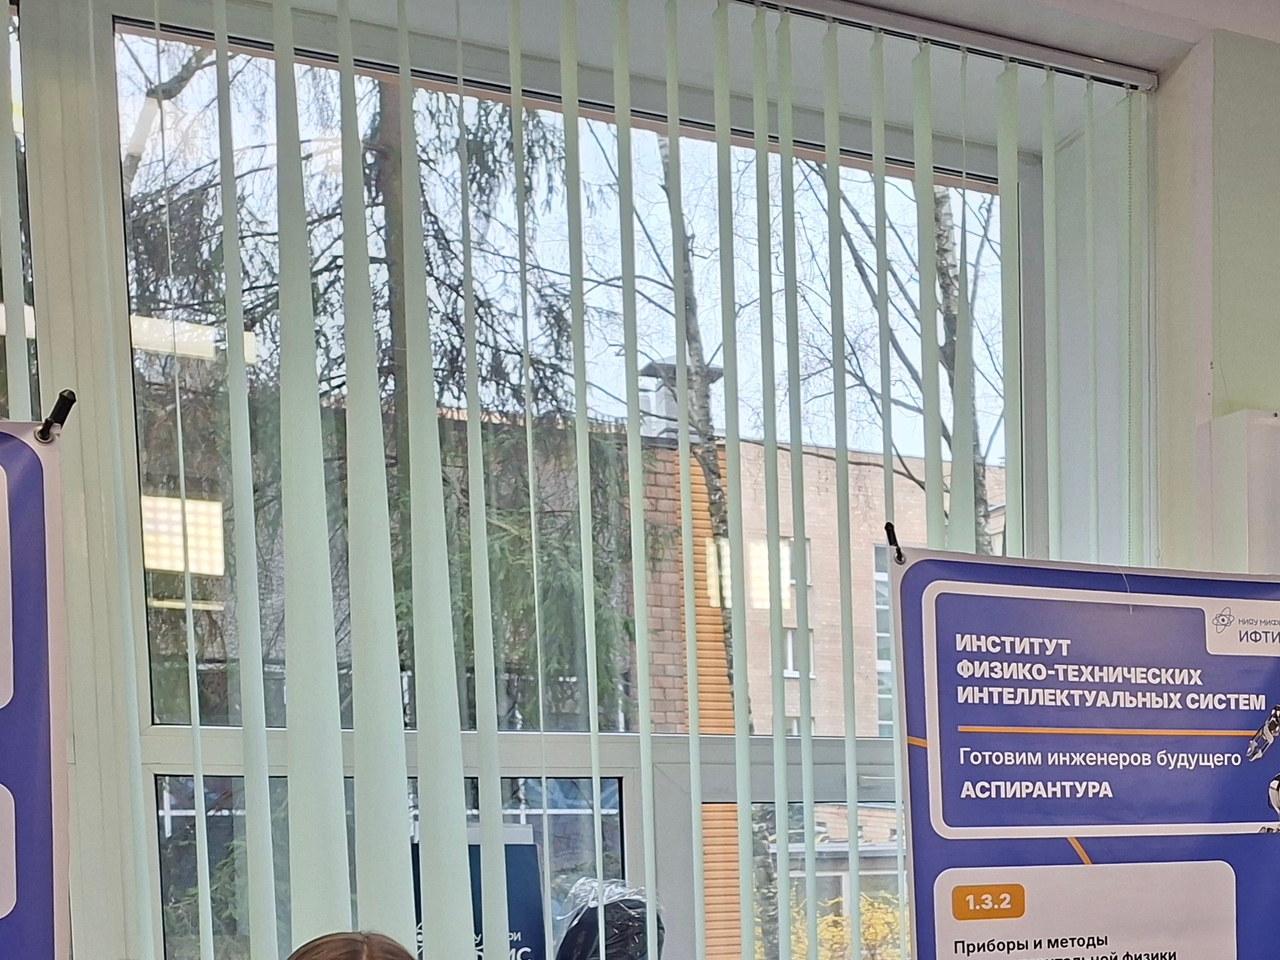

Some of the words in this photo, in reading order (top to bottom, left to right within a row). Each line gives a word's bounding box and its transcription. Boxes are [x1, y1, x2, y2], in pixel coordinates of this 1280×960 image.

[1238, 617, 1259, 627] НИЯУ
[955, 633, 1071, 656] ИНСТИТУТ
[956, 659, 1203, 686] ФИЗИКО-ТЕХНИЧЕСКИХ
[957, 686, 1182, 711] ИНТЕЛЛЕКТУАЛЬНЫХ
[1186, 691, 1266, 711] СИСТЕМ
[959, 746, 1042, 766] Готовим
[1047, 749, 1151, 771] инженеров
[1156, 749, 1242, 771] будущего
[960, 779, 1114, 799] АСПИРАНТУРА
[966, 893, 1012, 911] 1.3.2
[954, 937, 1029, 957] Приборы
[1033, 941, 1043, 950] и
[1047, 934, 1109, 951] методы
